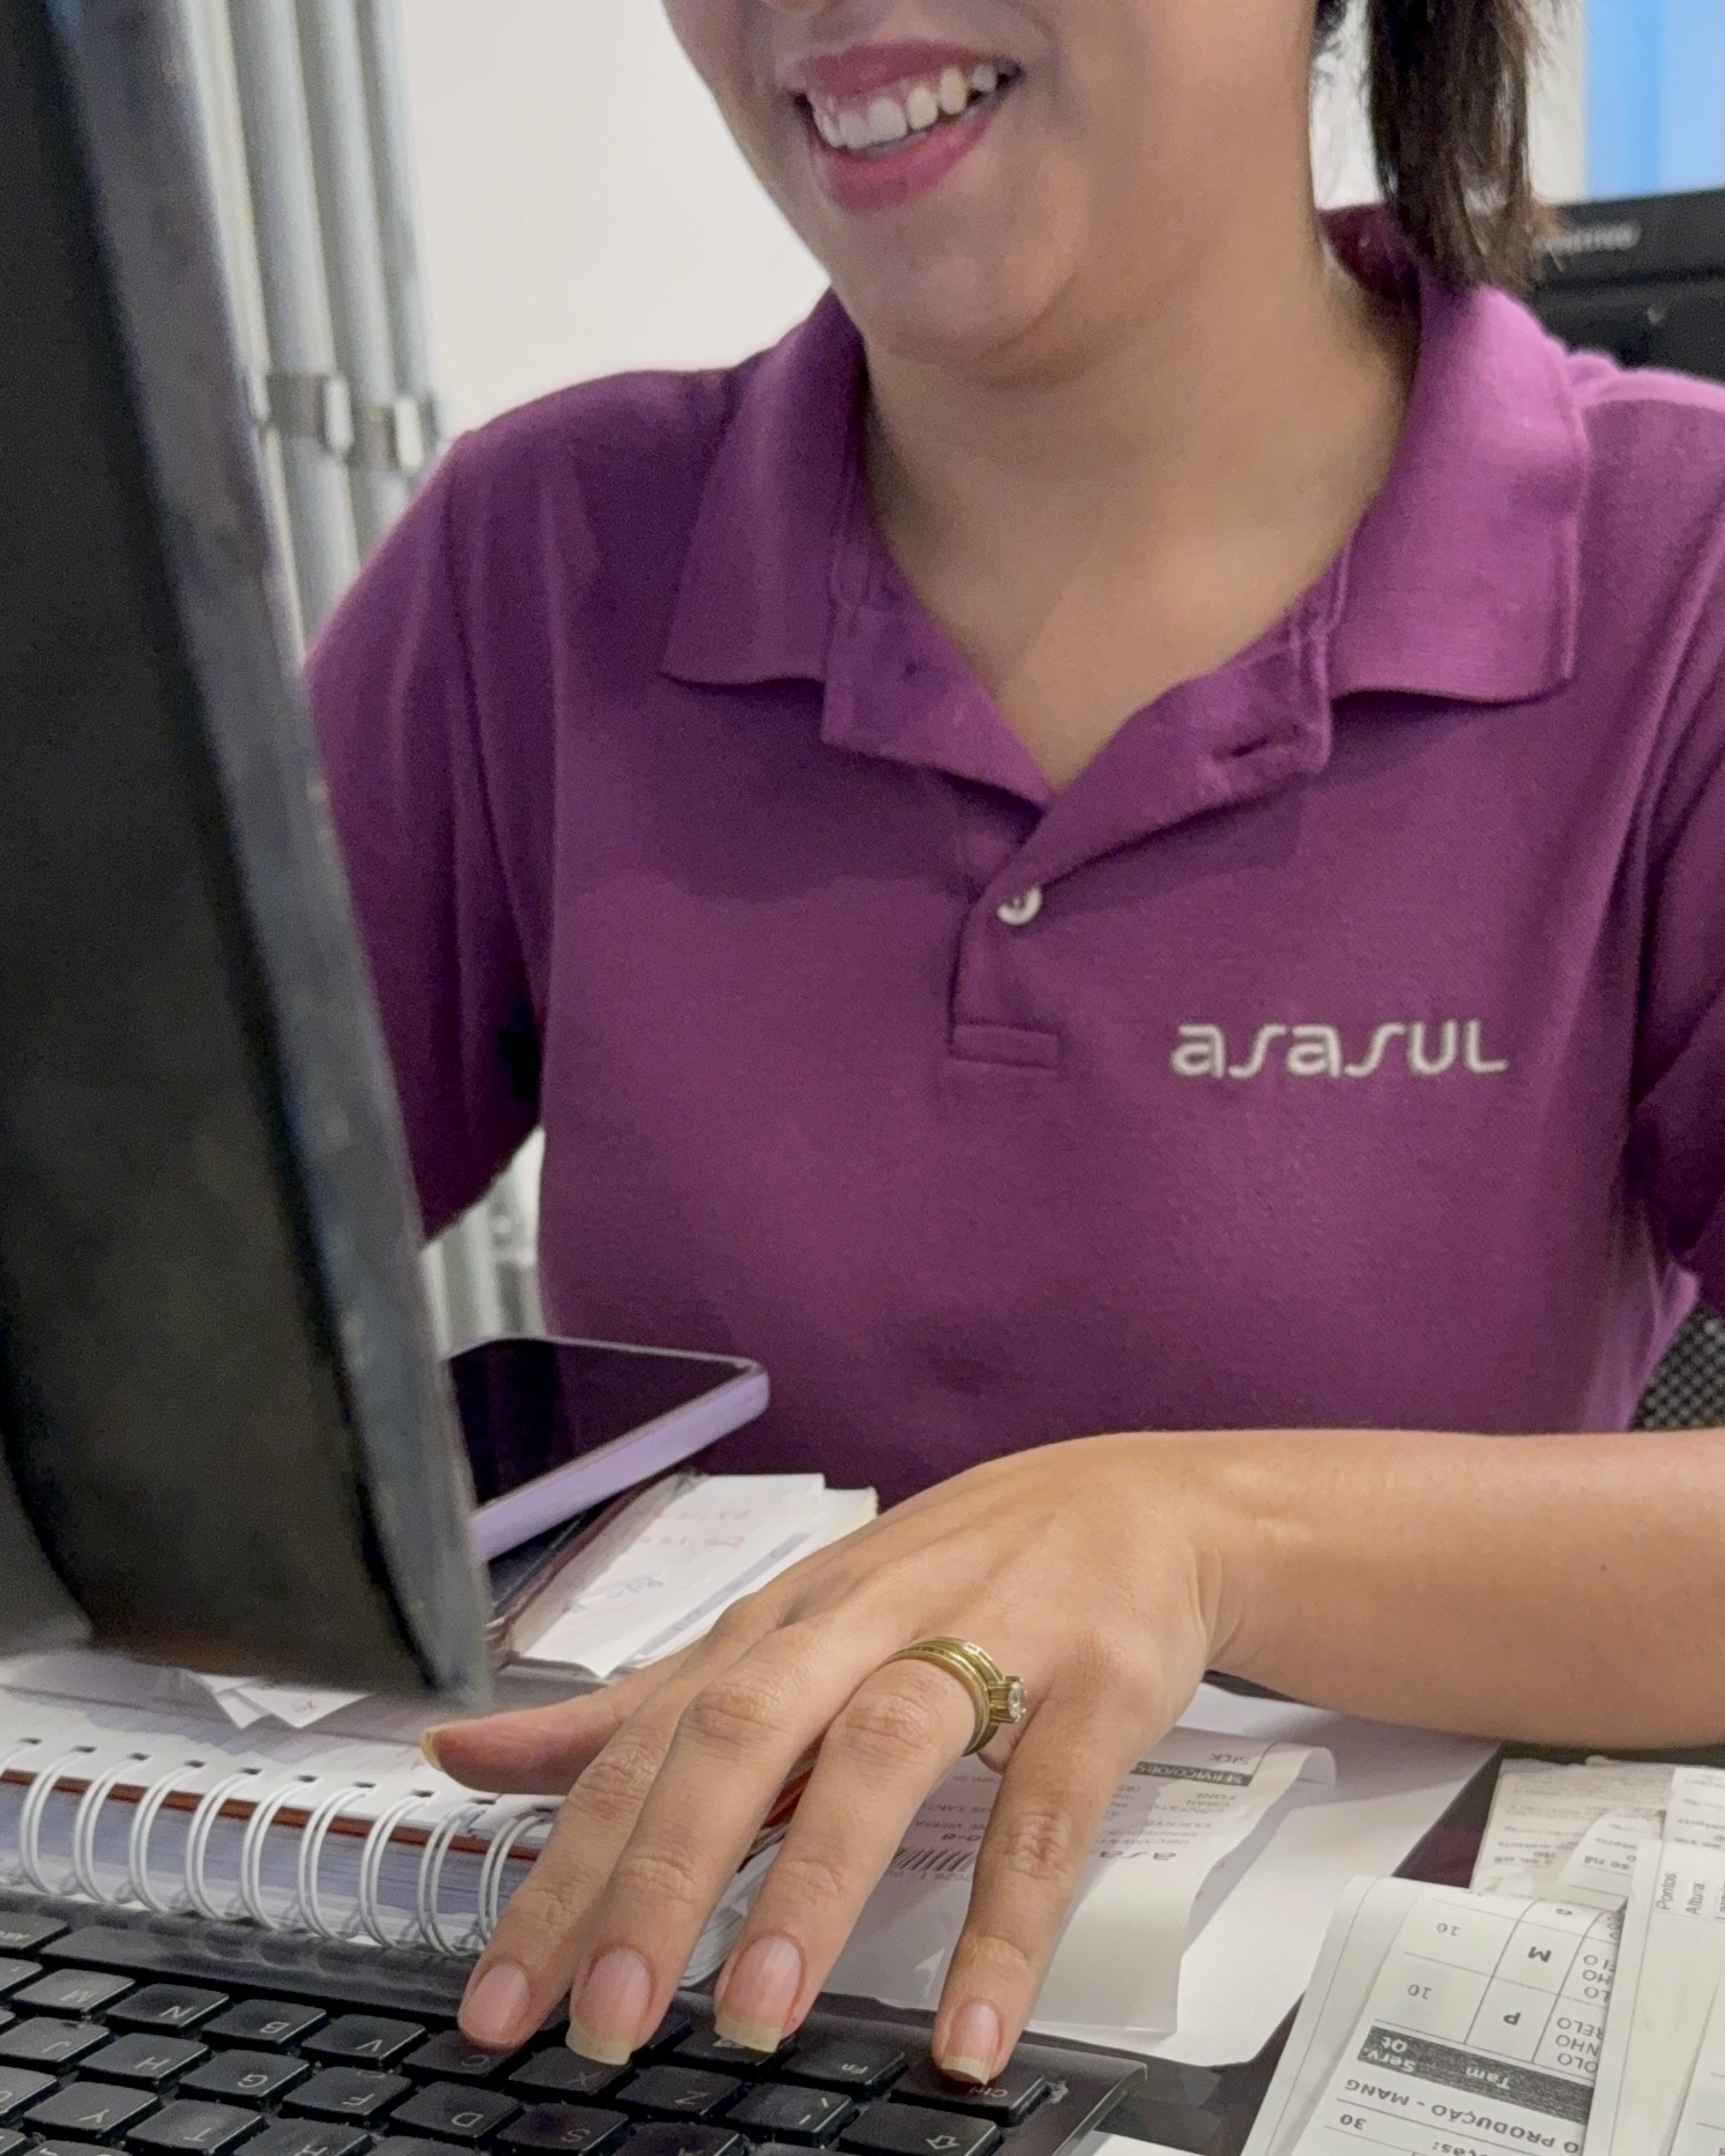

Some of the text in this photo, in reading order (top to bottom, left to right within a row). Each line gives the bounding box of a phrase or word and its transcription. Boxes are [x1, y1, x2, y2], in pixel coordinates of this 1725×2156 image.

[1656, 1873, 1677, 1910] Pontos
[1685, 1882, 1705, 1916] Altura
[1436, 1923, 1461, 1937] 10
[1527, 1945, 1552, 1963] M
[1407, 1983, 1433, 2000] 10
[158, 2005, 192, 2020] N
[1503, 2011, 1521, 2025] P
[259, 2021, 289, 2035] B
[40, 2041, 71, 2053] J
[354, 2039, 384, 2052] V
[1381, 2035, 1408, 2052] Qt
[134, 2056, 171, 2071] H
[460, 2054, 490, 2068] C
[1363, 2047, 1416, 2073] Serv.
[841, 2062, 868, 2075] Fn
[238, 2073, 269, 2089] G
[1465, 2065, 1512, 2090] Tam
[341, 2093, 376, 2106] F
[674, 2090, 710, 2106] Z
[1345, 2078, 1410, 2107] MANG
[78, 2108, 110, 2123] Y
[450, 2112, 484, 2127] D
[1339, 2113, 1367, 2131] 30
[1431, 2104, 1556, 2148] PRODUÇÃO
[182, 2127, 211, 2143] T
[560, 2127, 592, 2144] S
